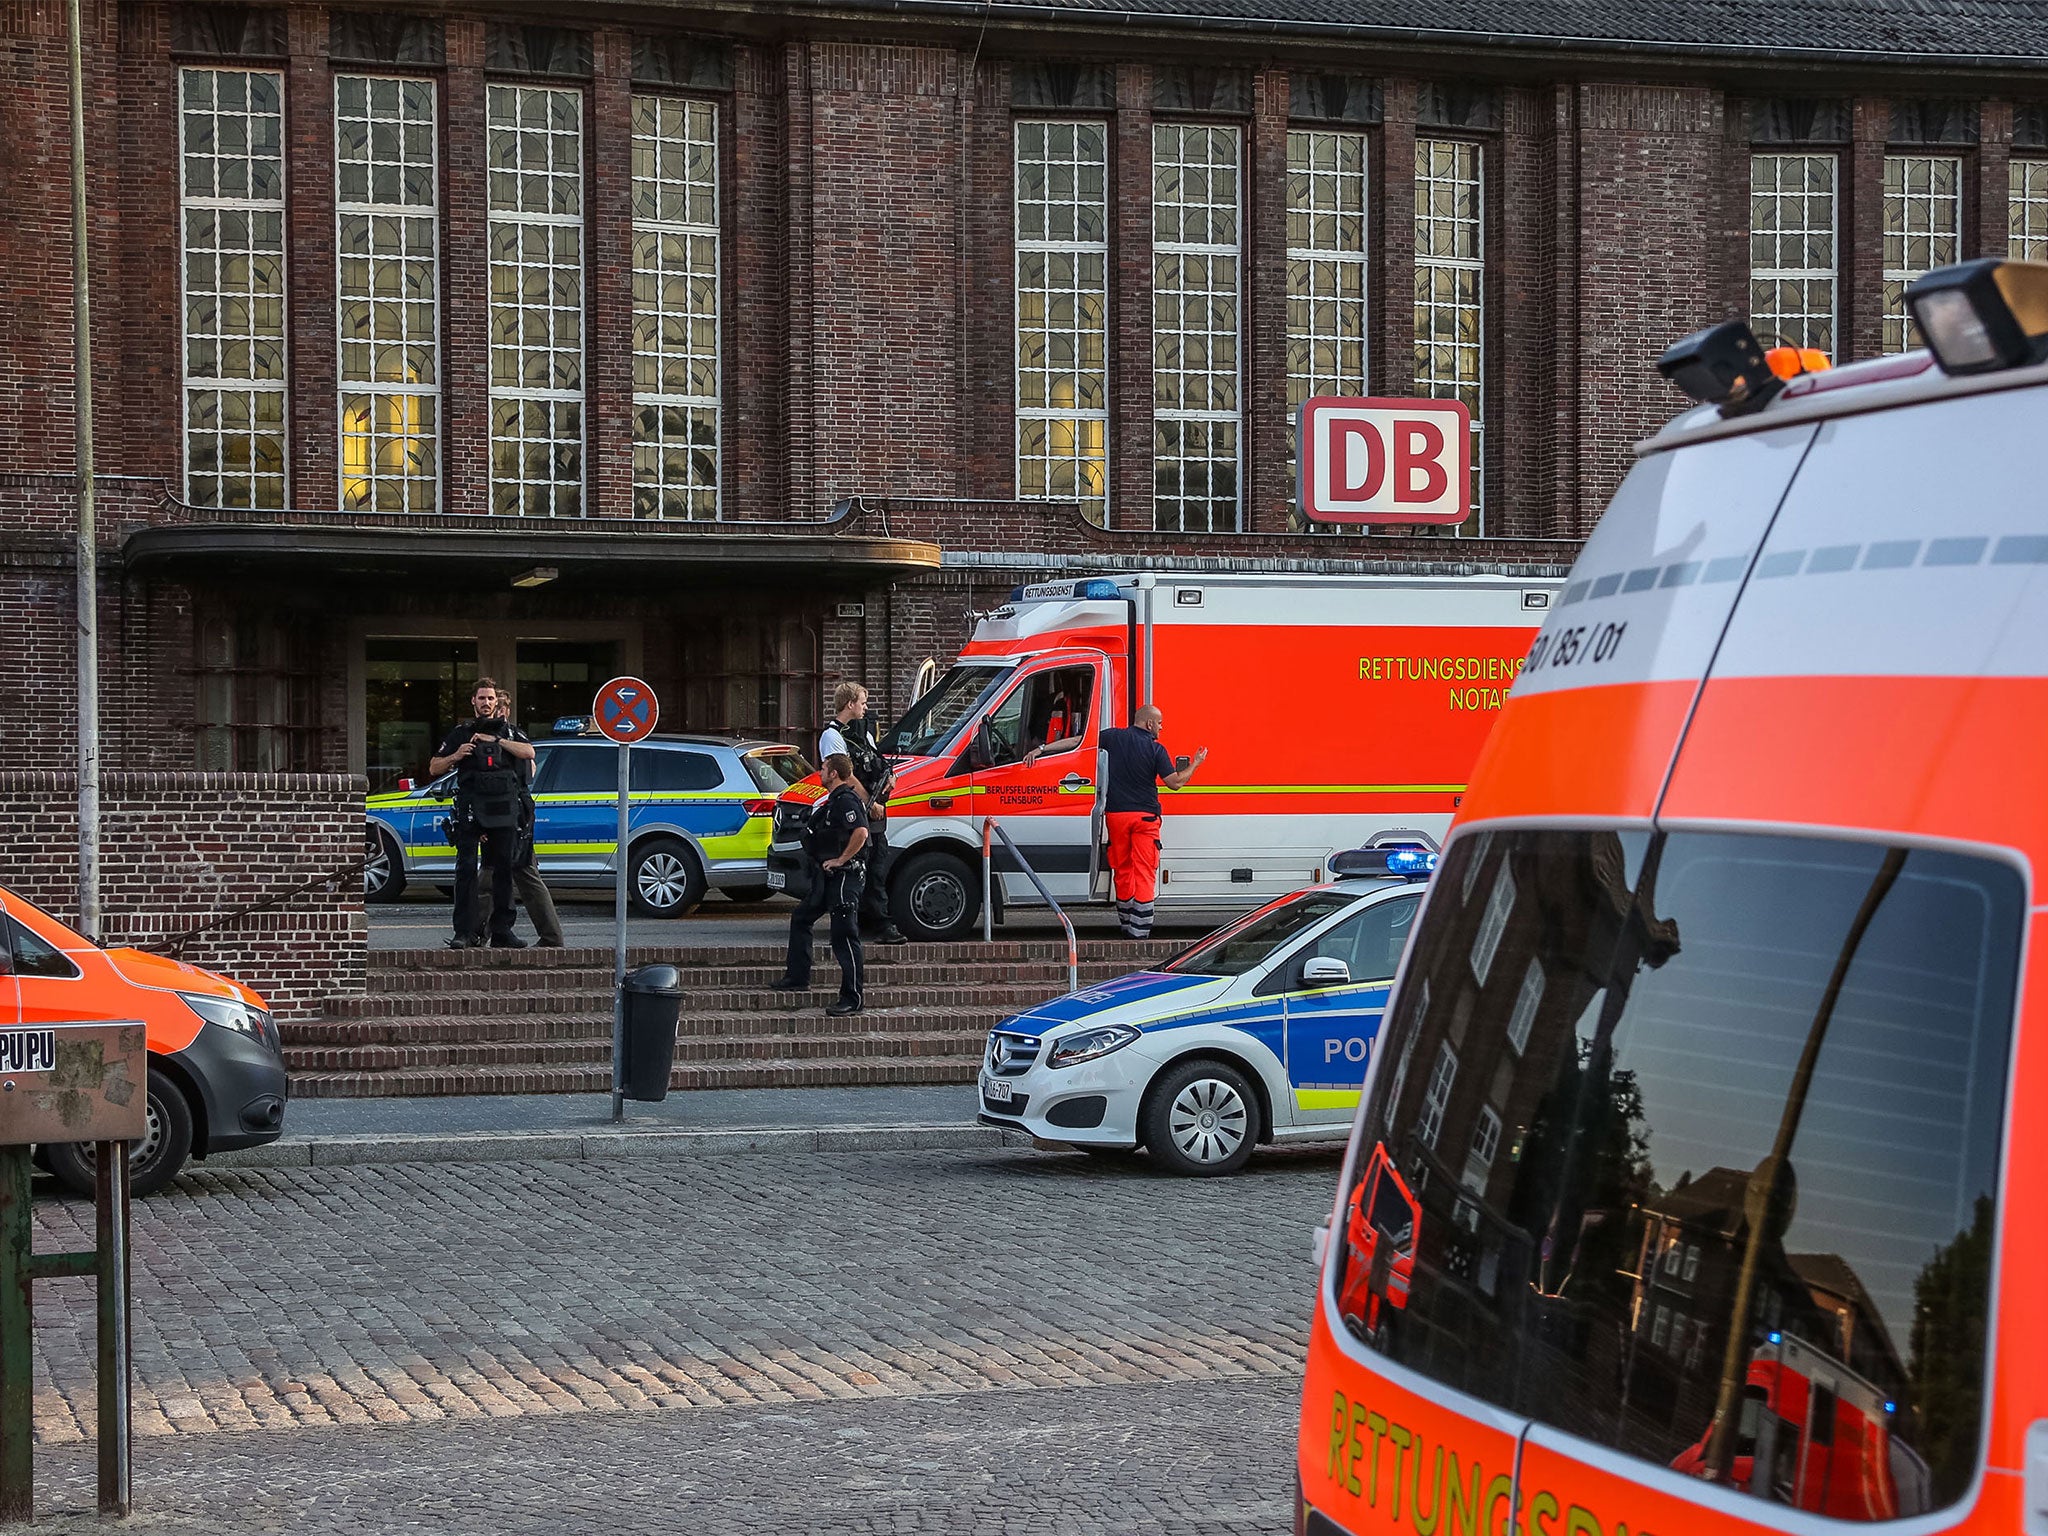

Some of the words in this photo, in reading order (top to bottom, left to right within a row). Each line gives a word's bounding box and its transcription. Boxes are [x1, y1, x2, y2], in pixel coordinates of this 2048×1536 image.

[1329, 418, 1448, 503] DB
[1025, 585, 1073, 598] RETTUNGSDIENST
[986, 785, 1059, 795] BERUFSFEUERWEHR
[1000, 795, 1043, 805] FLENSBURG
